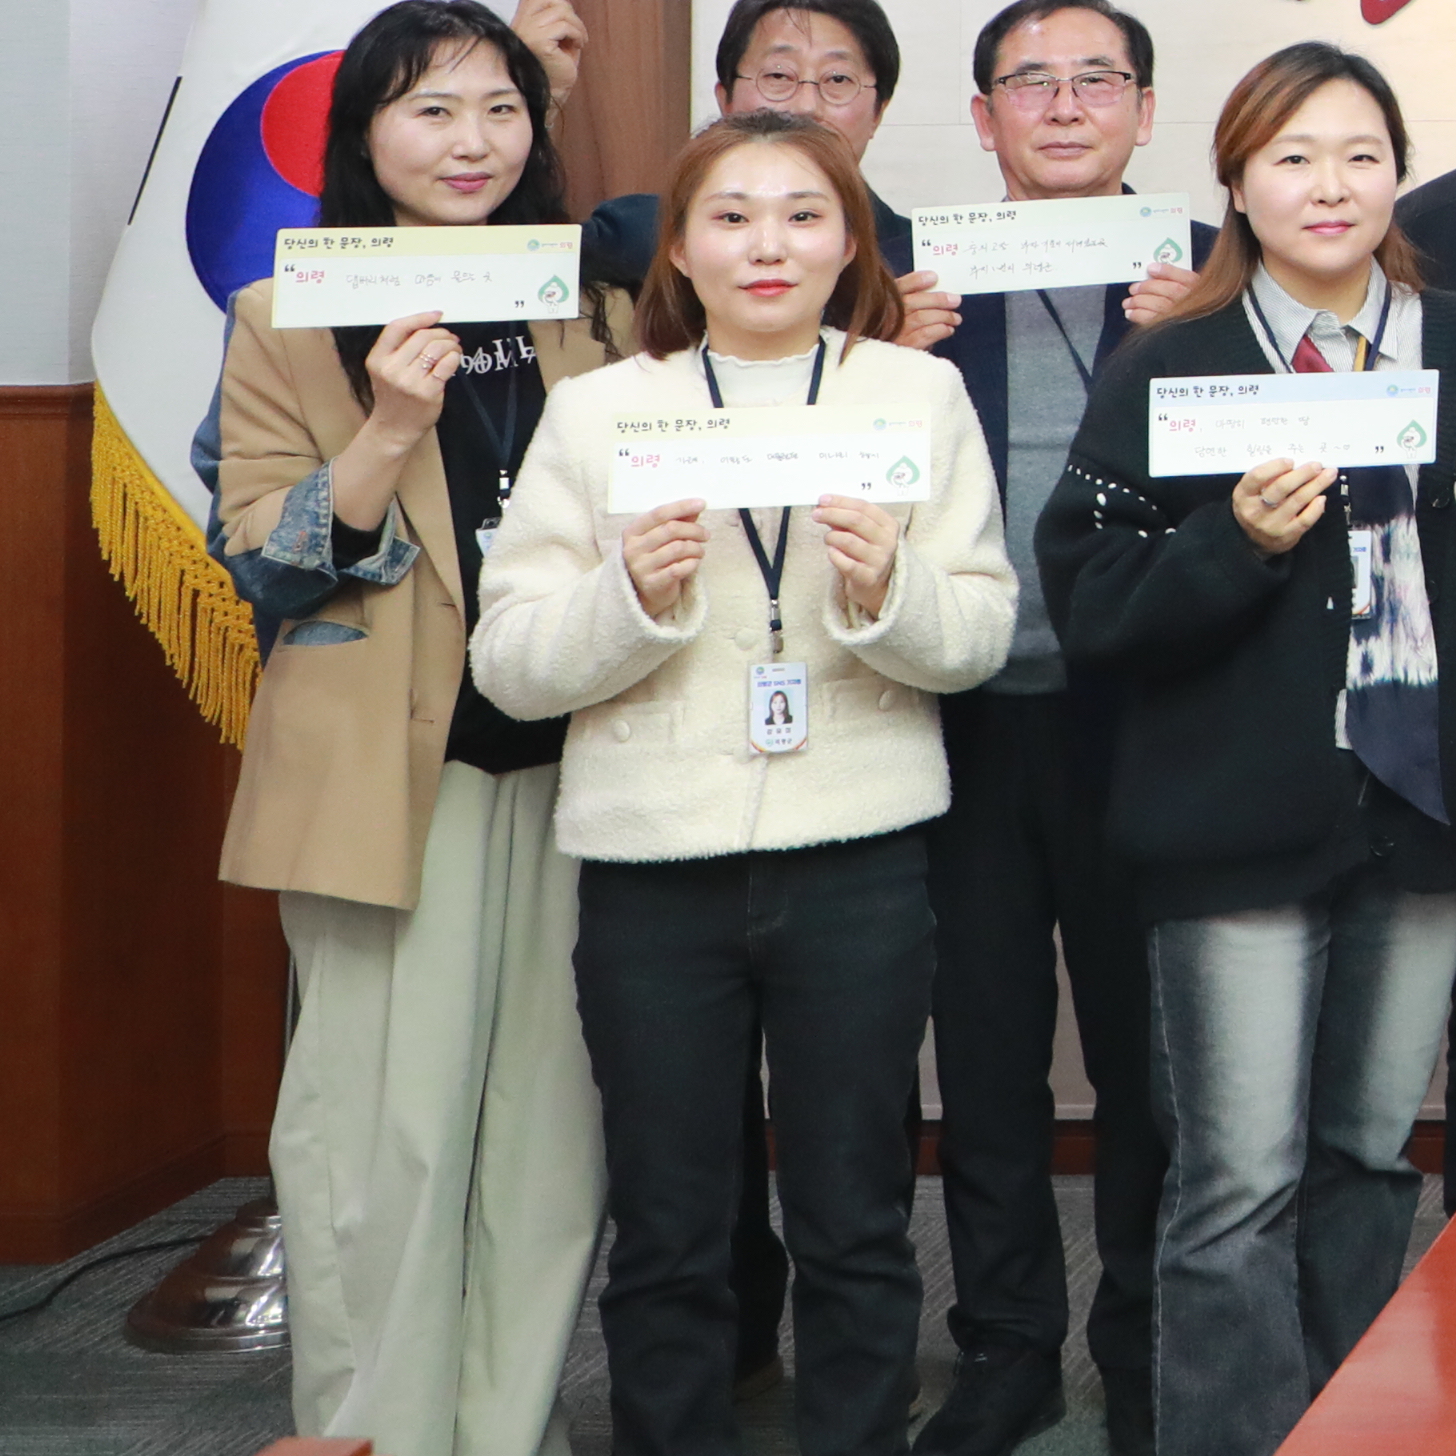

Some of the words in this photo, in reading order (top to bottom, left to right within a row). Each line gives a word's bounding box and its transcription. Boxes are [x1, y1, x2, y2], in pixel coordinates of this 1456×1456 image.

[918, 214, 949, 225] 당신의
[954, 214, 963, 224] 한
[969, 212, 992, 224] 문장,
[997, 211, 1016, 221] 의령
[284, 238, 318, 249] 당신의
[324, 237, 334, 248] 한
[340, 236, 366, 249] 문장,
[372, 237, 393, 248] 의령
[933, 244, 958, 256] 의령
[296, 270, 325, 284] 의령
[1157, 386, 1188, 397] 당신의
[1194, 386, 1203, 397] 한
[1209, 385, 1233, 397] 문장,
[1238, 384, 1259, 395] 의령
[617, 421, 652, 433] 당신의
[657, 420, 668, 431] 한
[675, 419, 702, 431] 문장,
[707, 418, 730, 430] 의령
[1169, 419, 1196, 432] 의령
[632, 454, 660, 468] 의령
